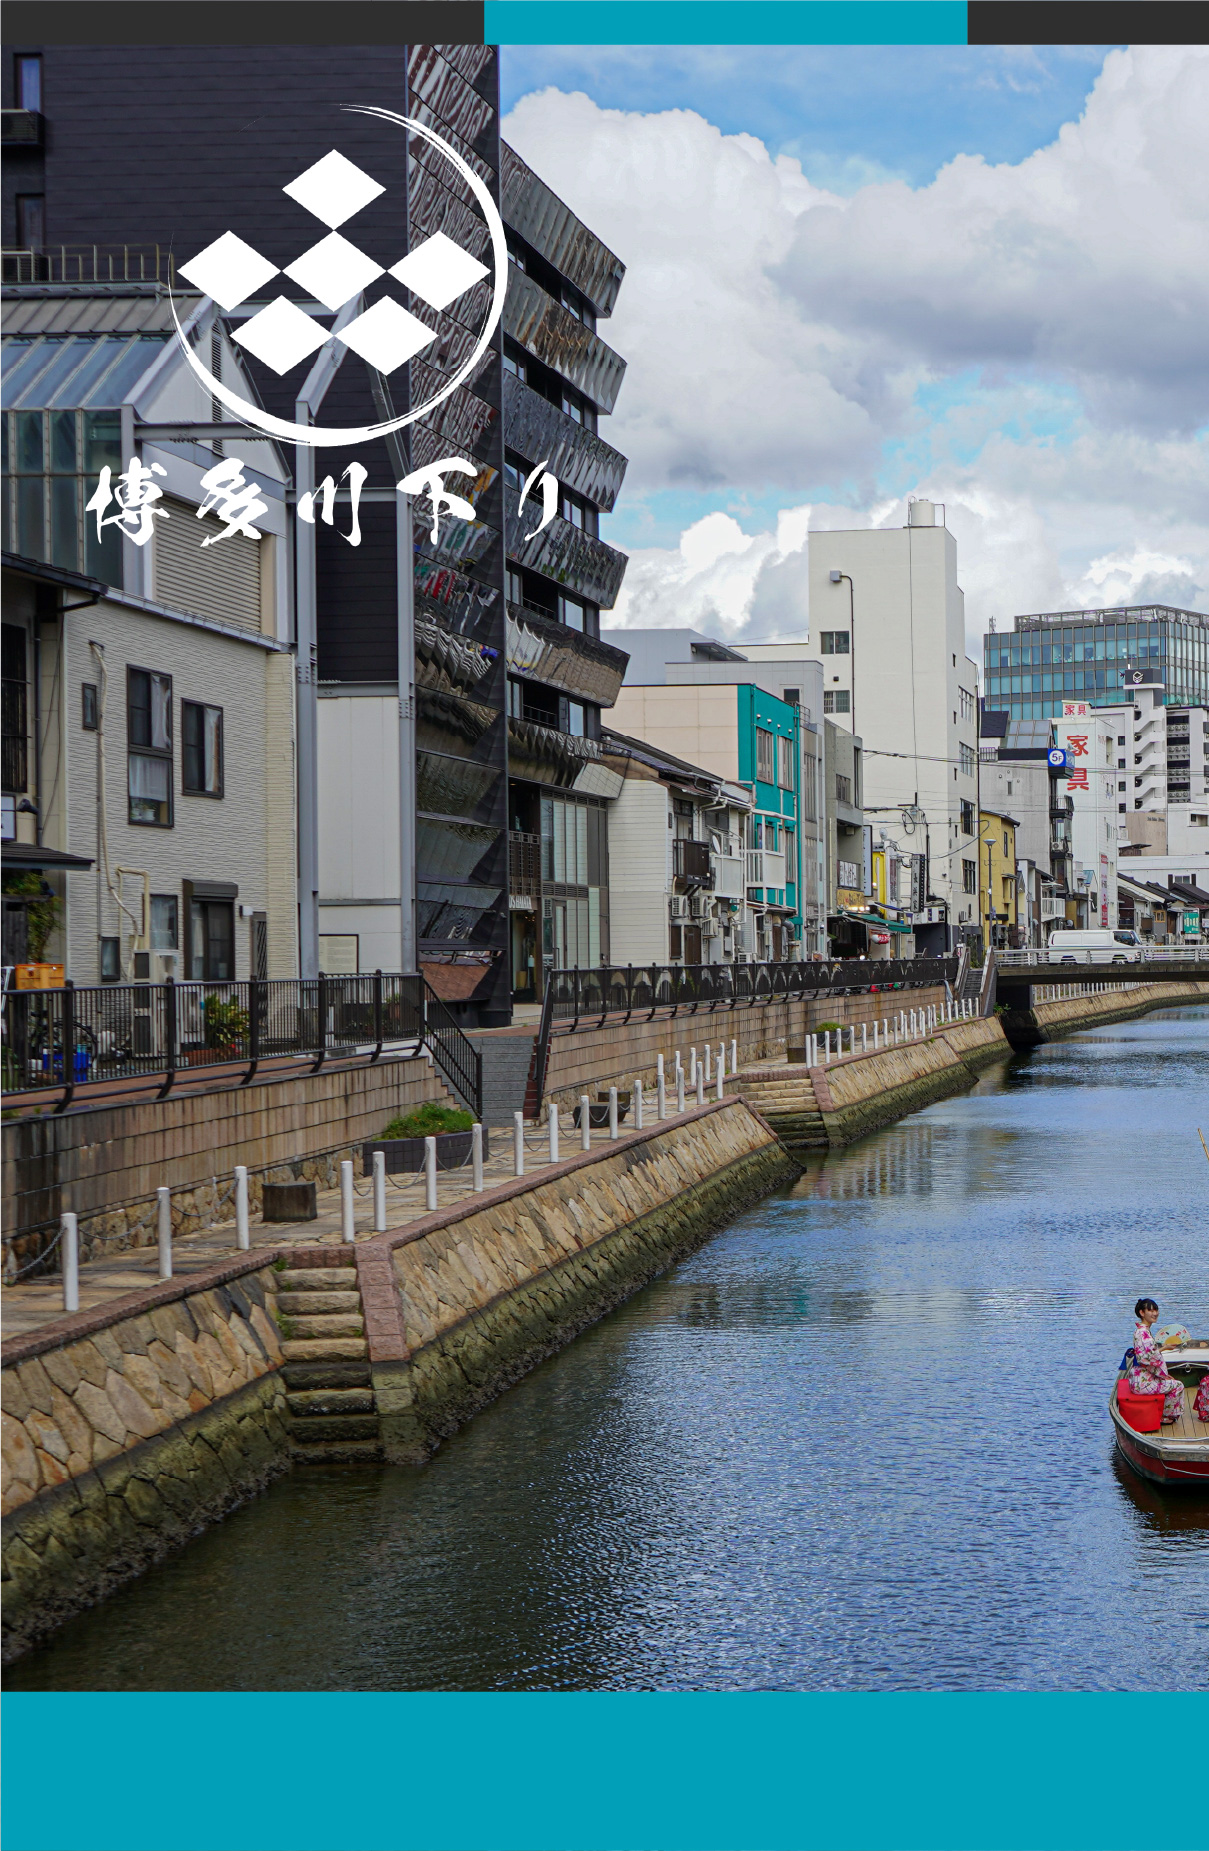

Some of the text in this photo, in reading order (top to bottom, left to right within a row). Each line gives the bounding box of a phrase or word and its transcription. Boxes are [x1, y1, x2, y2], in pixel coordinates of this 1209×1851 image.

[1064, 704, 1087, 716] 家具
[1051, 753, 1063, 763] 5F
[1066, 735, 1090, 791] 家具
